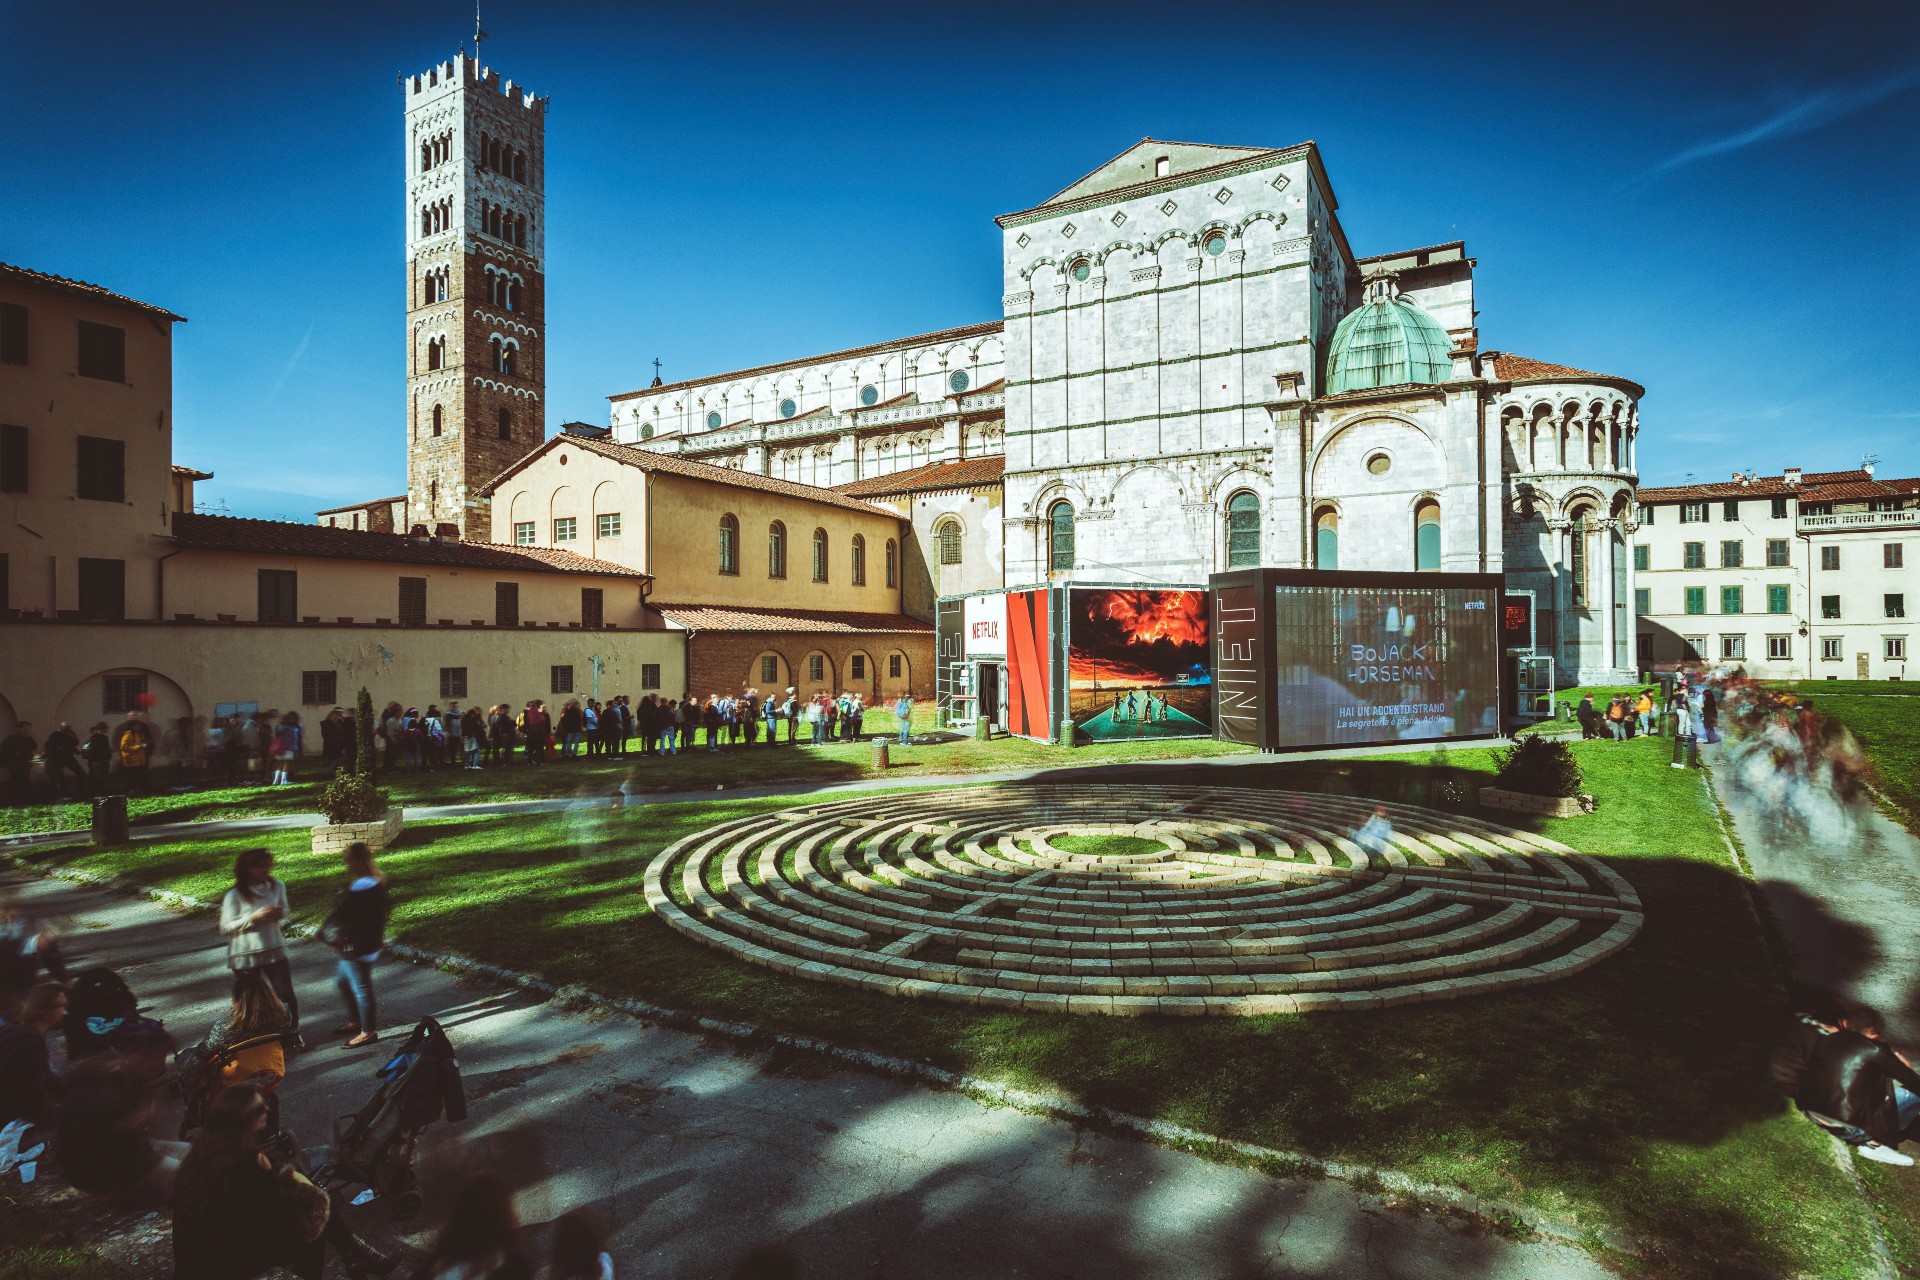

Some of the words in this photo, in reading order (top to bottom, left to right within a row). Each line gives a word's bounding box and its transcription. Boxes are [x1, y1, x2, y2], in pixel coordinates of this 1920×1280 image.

[1464, 601, 1486, 610] NETFLIX
[972, 620, 999, 640] NETFLIX
[1350, 644, 1427, 662] BOJACK
[1346, 665, 1437, 684] HORSEMAN
[1339, 707, 1355, 718] HAI
[1357, 706, 1371, 717] UN
[1372, 704, 1411, 716] ACCENTO
[1412, 702, 1446, 715] STRANO
[1337, 720, 1347, 730] La
[1348, 717, 1389, 730] segreteria
